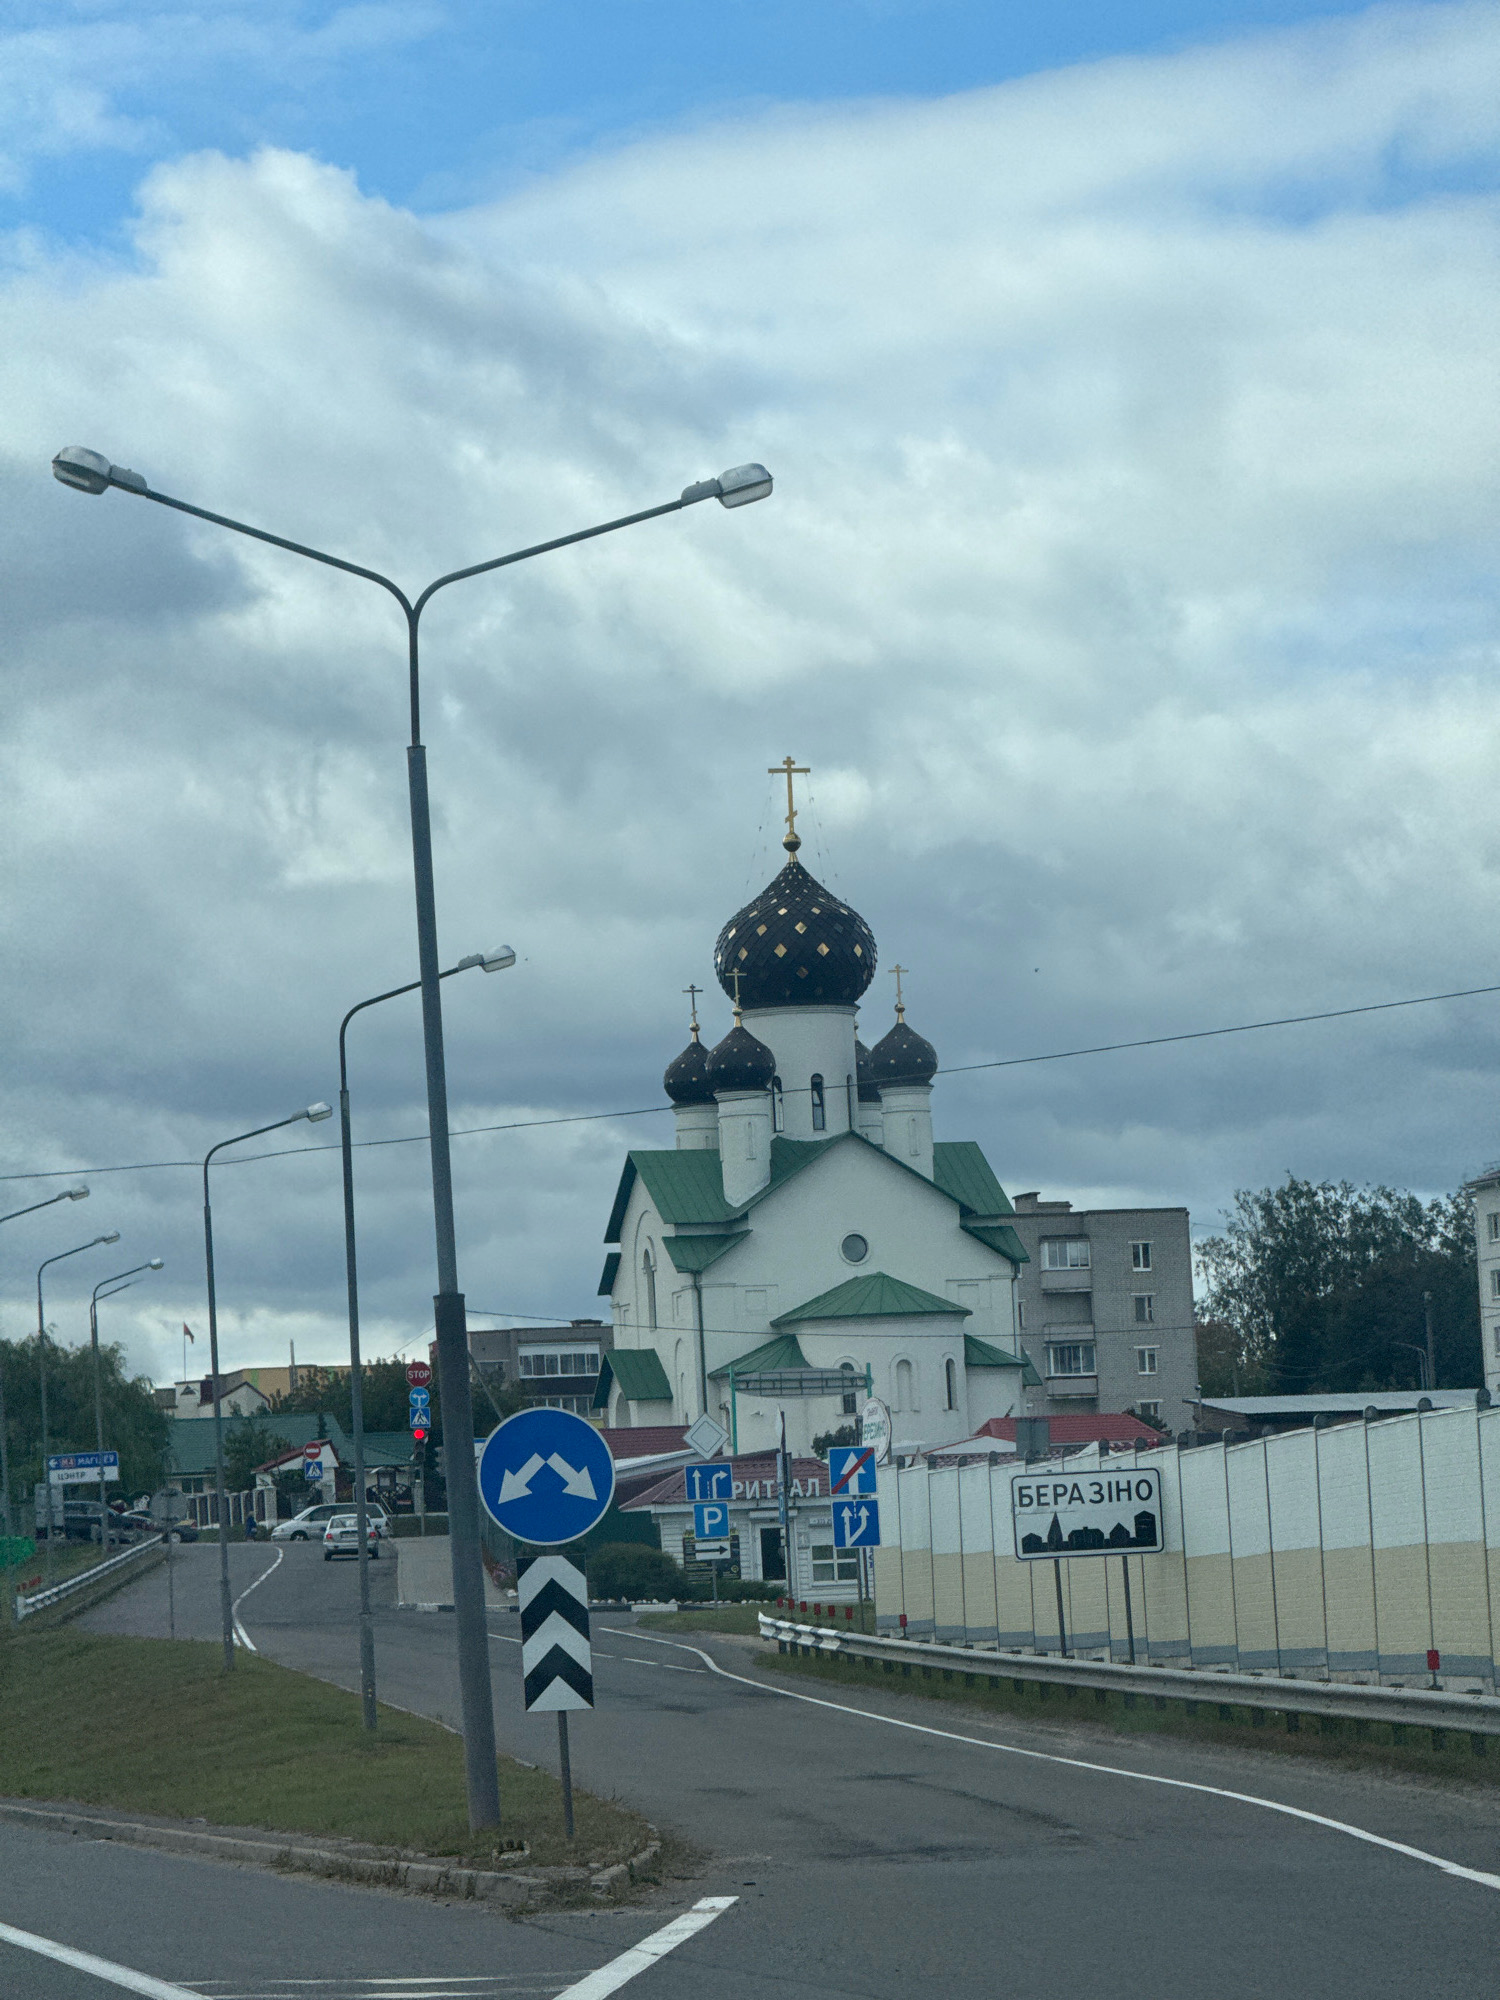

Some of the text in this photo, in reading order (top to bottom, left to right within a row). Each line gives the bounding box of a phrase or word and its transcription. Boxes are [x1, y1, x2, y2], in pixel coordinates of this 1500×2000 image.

[408, 1370, 430, 1379] STOP
[57, 1471, 86, 1480] ЦЭНТР
[732, 1478, 820, 1500] РИТАЛ
[1018, 1478, 1153, 1508] БЕРАЗІНО
[703, 1507, 723, 1535] P
